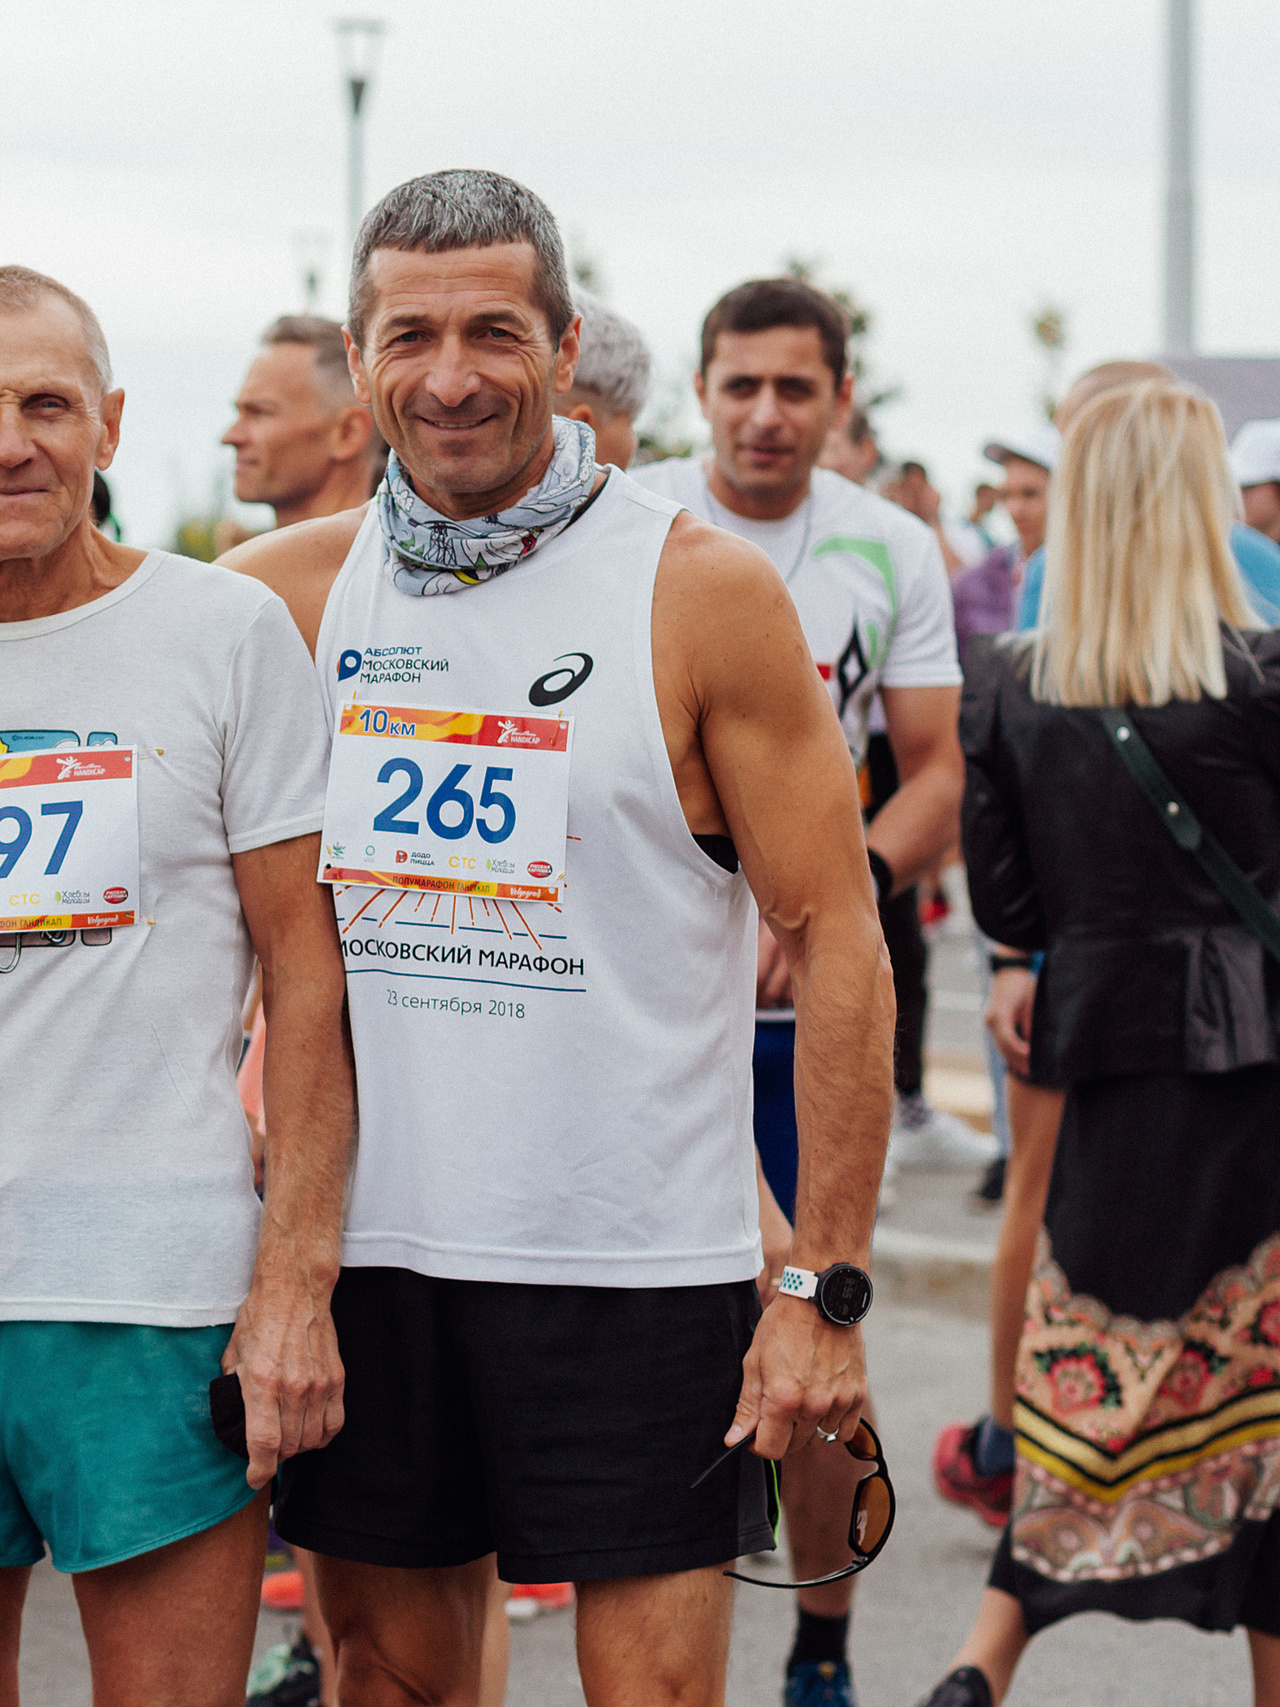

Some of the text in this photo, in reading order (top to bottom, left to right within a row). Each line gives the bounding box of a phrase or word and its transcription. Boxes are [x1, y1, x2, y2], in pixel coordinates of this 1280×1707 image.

[363, 646, 423, 657] АБСОЛЮТ
[361, 658, 449, 672] МОСКОВСКИЙ
[360, 672, 422, 684] МАРАФОН
[373, 757, 517, 844] 265
[448, 856, 477, 870] СТС
[392, 875, 455, 889] ПОЛУМАРАФОН
[9, 893, 41, 906] СТС
[478, 949, 585, 976] МАРАФОН
[401, 995, 482, 1016] сентября
[488, 999, 526, 1019] 2018
